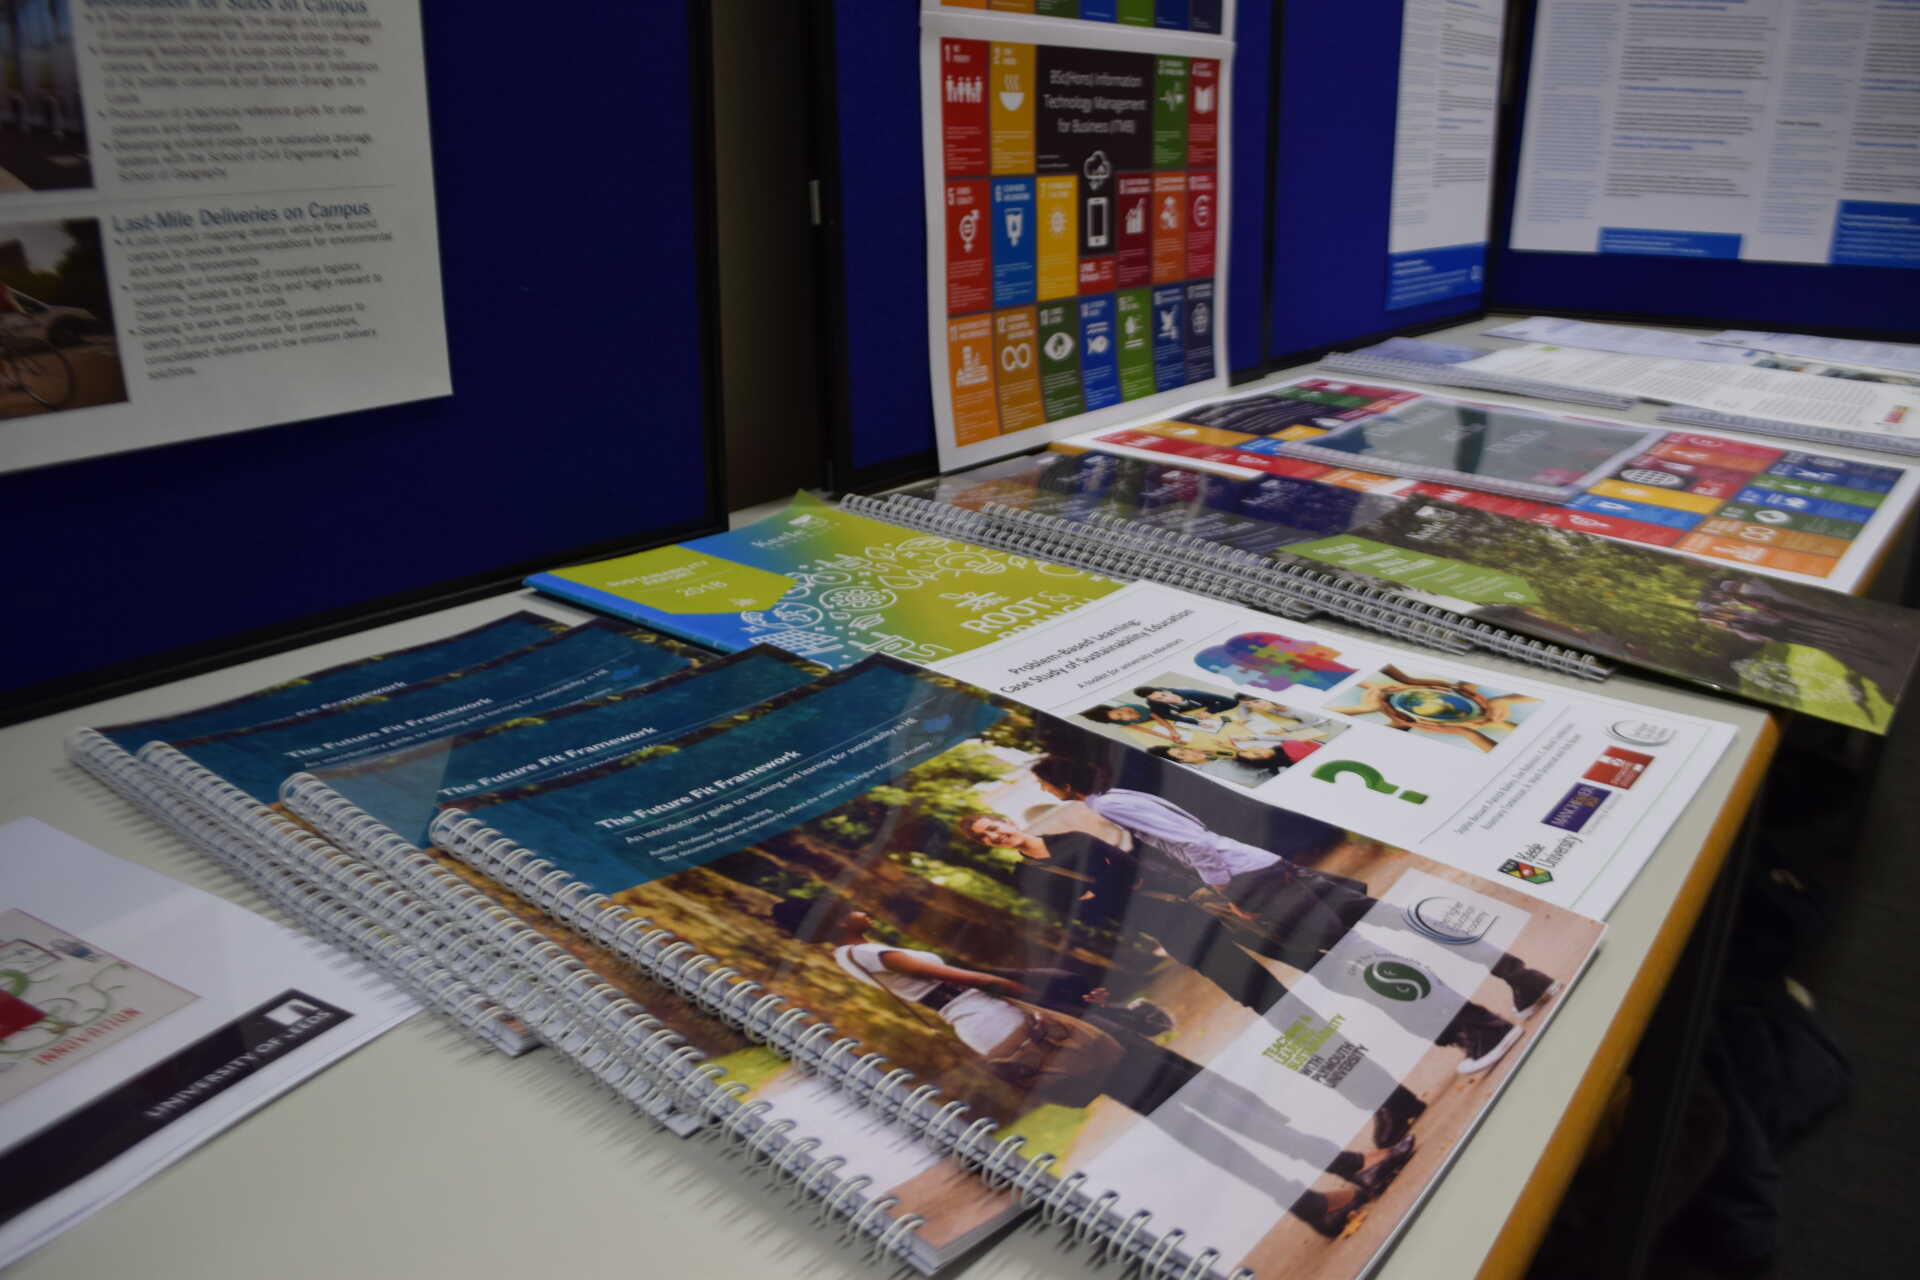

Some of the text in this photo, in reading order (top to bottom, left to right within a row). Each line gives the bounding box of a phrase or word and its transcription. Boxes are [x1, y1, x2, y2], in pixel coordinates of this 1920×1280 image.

[304, 0, 368, 15] Campus
[1094, 72, 1143, 88] Information
[1043, 93, 1147, 114] Technology Management
[1056, 117, 1072, 134] for
[1071, 118, 1109, 134] Business
[112, 201, 371, 232] Last-Mile Deliveries on Campus
[959, 597, 1051, 634] ROOT
[1000, 608, 1195, 695] Case Study of Sustainability Education
[283, 696, 495, 760] The Future Fit Framework
[436, 778, 480, 796] The
[476, 761, 541, 787] Future
[537, 749, 568, 768] Fit
[563, 725, 660, 759] Framework
[593, 748, 802, 831] The Future Fit Framework
[642, 812, 709, 841] introductory
[706, 801, 735, 819] guide
[744, 779, 788, 803] teaching
[798, 757, 838, 779] learning
[846, 727, 898, 755] sustainability
[146, 1048, 264, 1119] UNIVERSITY
[255, 1035, 284, 1055] OF
[1297, 1053, 1326, 1077] WITH
[1310, 1040, 1355, 1083] PLYMOUTH
[1323, 1043, 1370, 1089] UNIVERSITY
